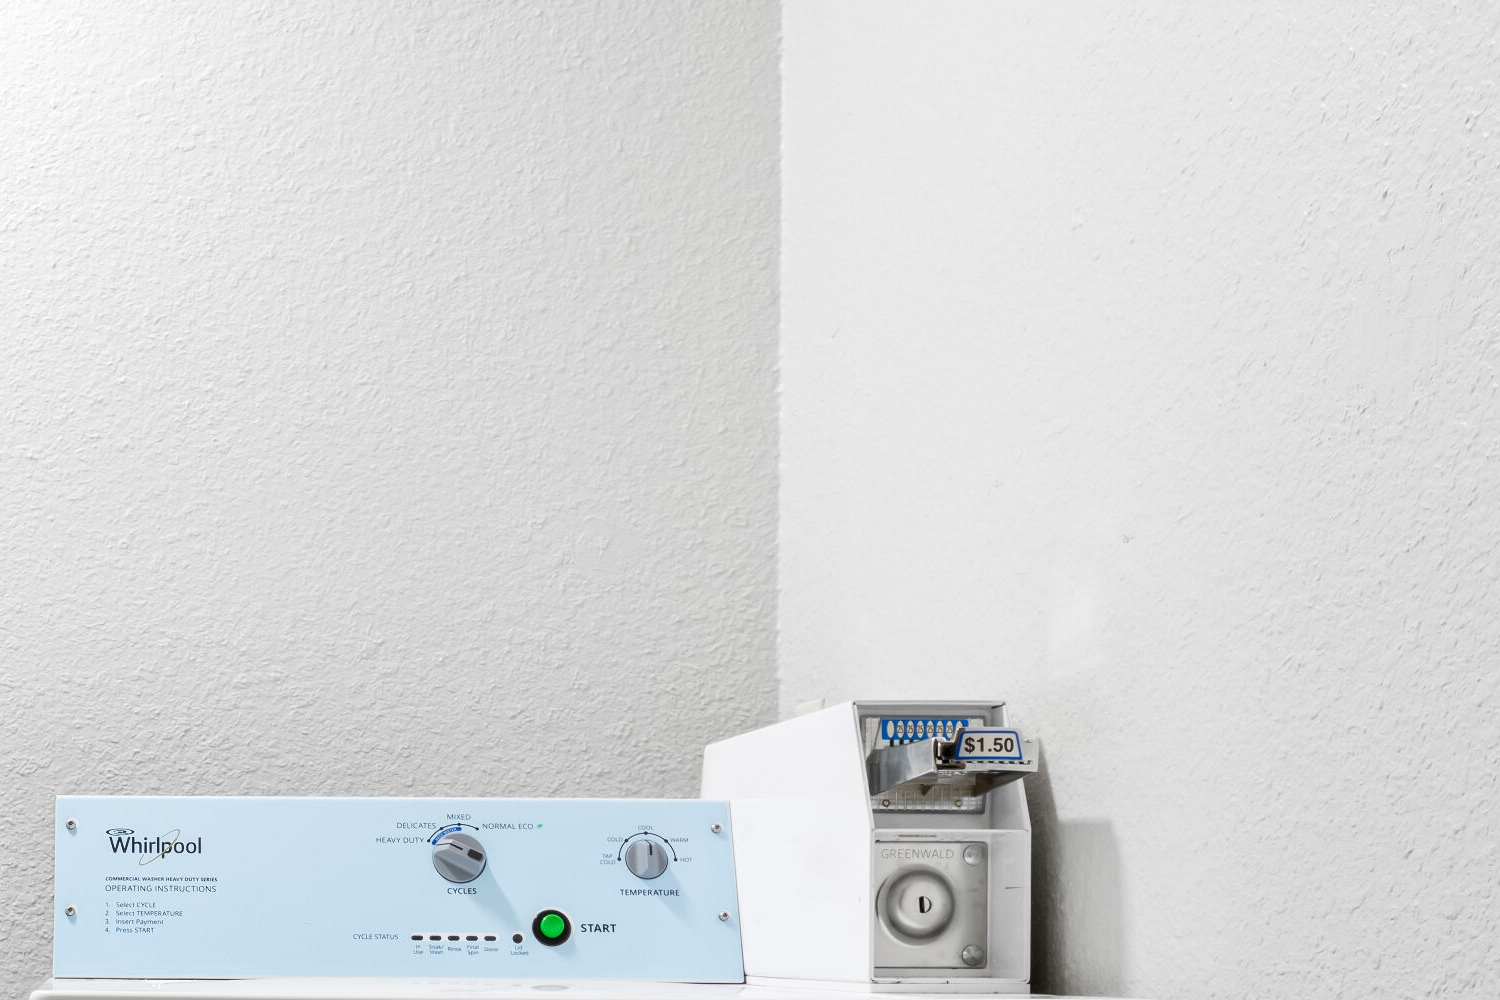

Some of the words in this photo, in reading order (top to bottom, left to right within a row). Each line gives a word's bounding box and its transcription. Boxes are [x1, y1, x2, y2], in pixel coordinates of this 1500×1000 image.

[897, 724, 904, 734] 25
[907, 724, 914, 734] 25
[917, 724, 924, 734] 25
[927, 724, 934, 734] 25
[936, 724, 943, 734] 25
[964, 736, 1014, 753] $1.50
[446, 813, 472, 821] MIXED
[375, 836, 401, 844] HEAVY
[402, 836, 425, 844] DUTY
[109, 836, 202, 859] Whirlpool
[881, 848, 955, 860] GREENWALD
[105, 884, 153, 892] OPERATING
[154, 885, 217, 893] INSTRUCTIONS
[447, 887, 477, 895] CYCLES
[620, 888, 680, 897] TEMPERATURE
[135, 918, 164, 926] Payment
[580, 923, 617, 933] START
